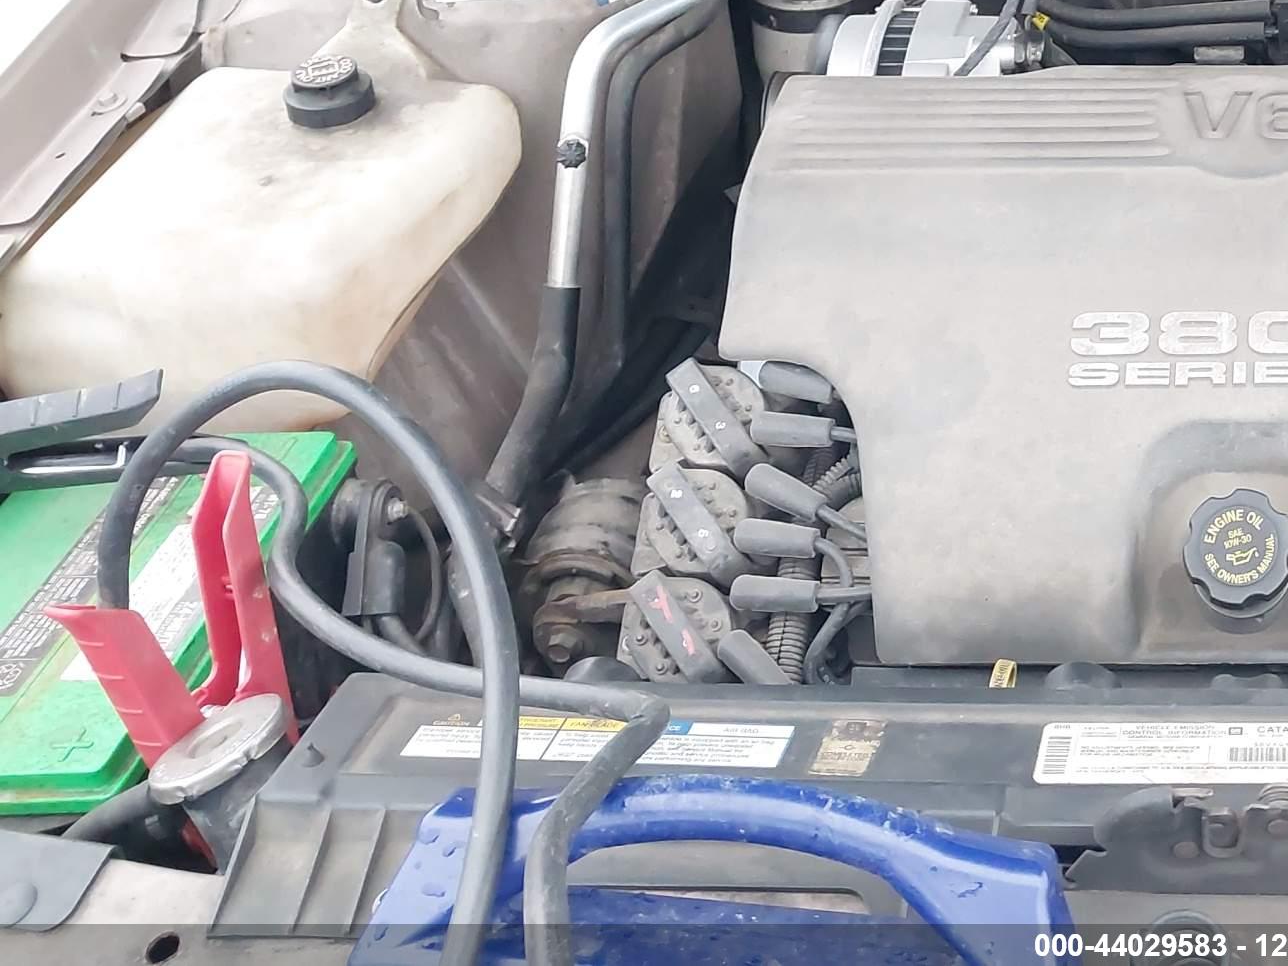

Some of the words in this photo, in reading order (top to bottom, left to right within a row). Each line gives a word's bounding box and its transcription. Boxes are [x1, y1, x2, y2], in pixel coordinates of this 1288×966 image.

[1203, 509, 1244, 544] ENGINE
[1246, 511, 1264, 530] OIL
[1228, 527, 1244, 539] SAE
[1223, 534, 1252, 549] 10W-30
[1204, 553, 1219, 574] SEE
[1217, 568, 1259, 584] OWNER'S
[1256, 533, 1275, 574] MANUAL
